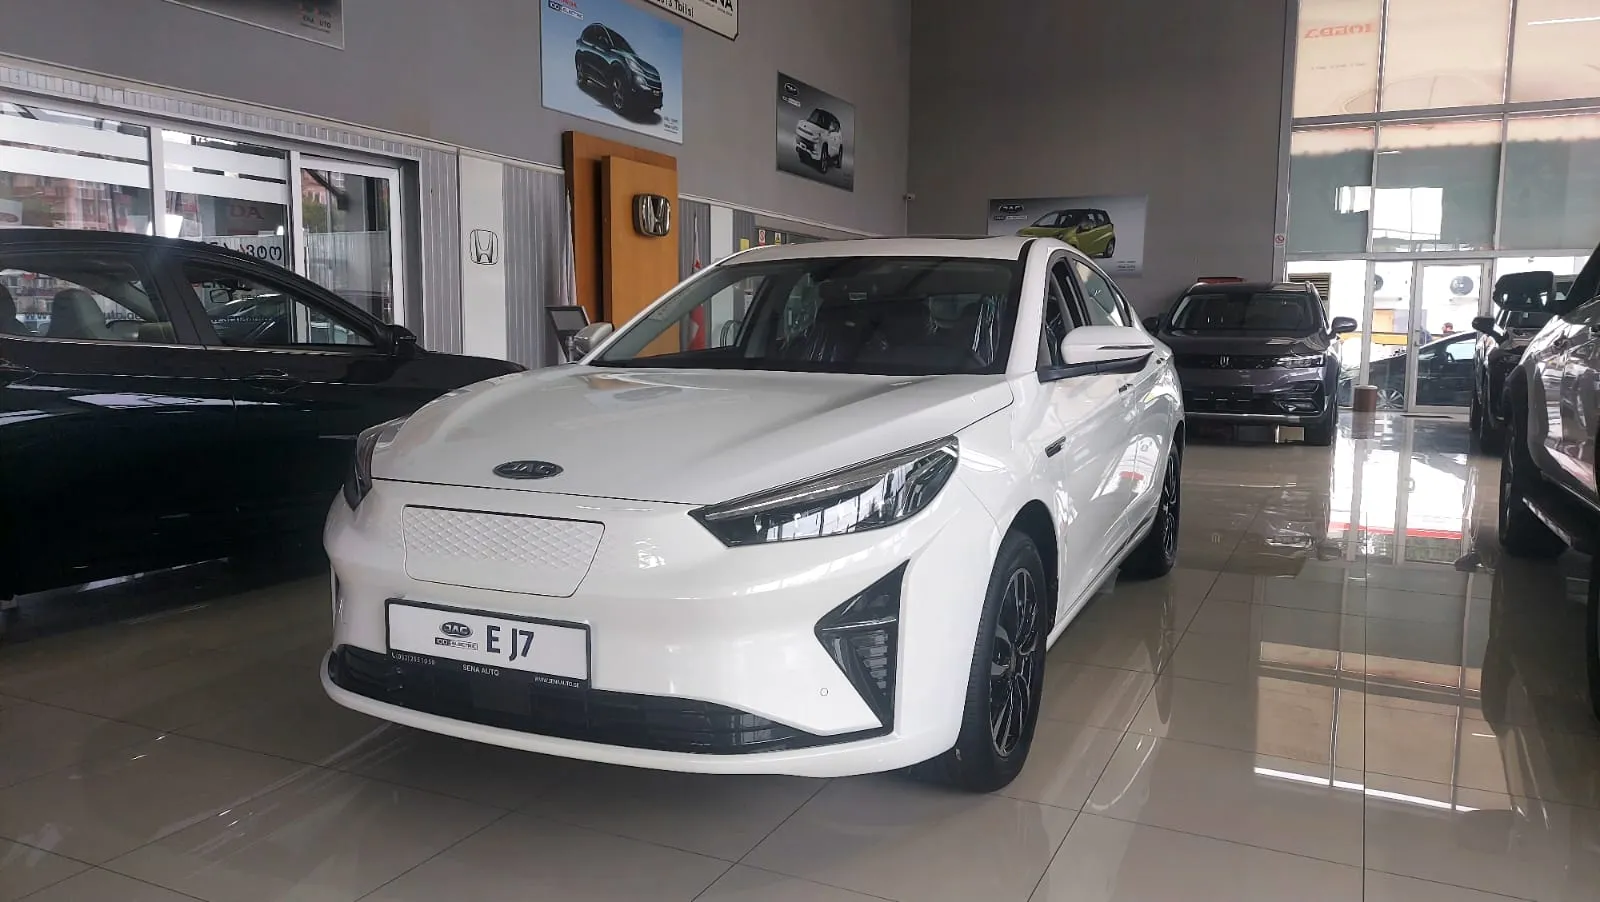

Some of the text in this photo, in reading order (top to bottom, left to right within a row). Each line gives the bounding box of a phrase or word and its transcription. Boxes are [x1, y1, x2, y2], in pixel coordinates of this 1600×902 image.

[486, 624, 534, 661] E J7
[462, 664, 500, 677] SENA AUTO
